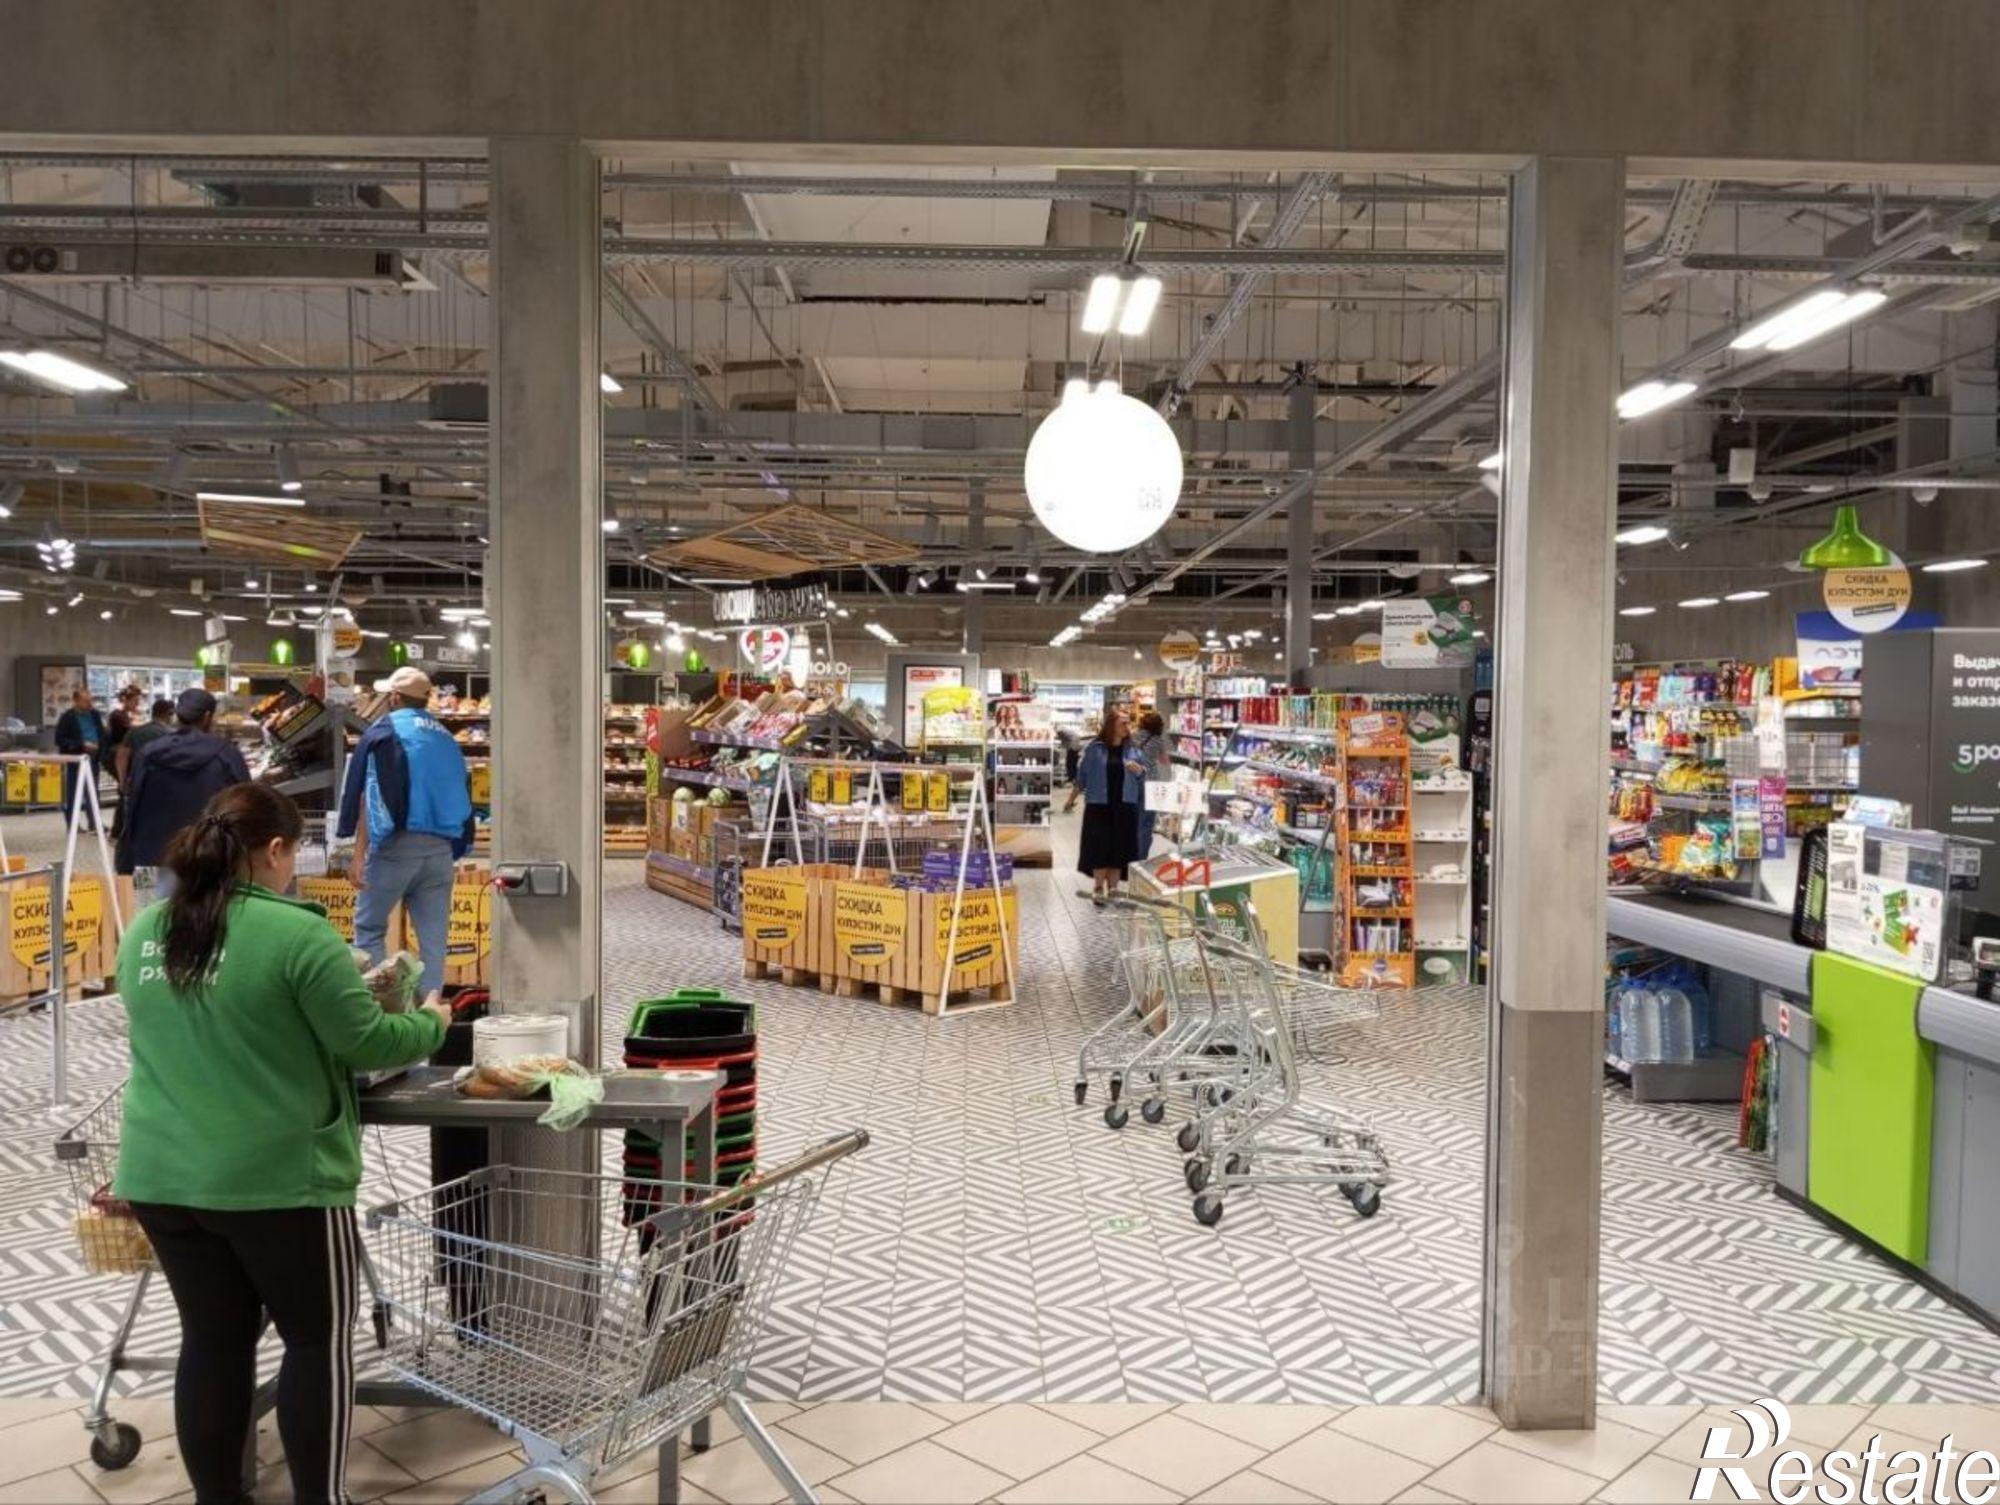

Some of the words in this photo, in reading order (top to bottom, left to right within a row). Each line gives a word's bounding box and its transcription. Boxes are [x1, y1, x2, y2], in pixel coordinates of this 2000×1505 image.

[1844, 574, 1889, 585] СКИДКА
[745, 884, 787, 901] СКИДКА
[838, 896, 883, 915] СКИДКА
